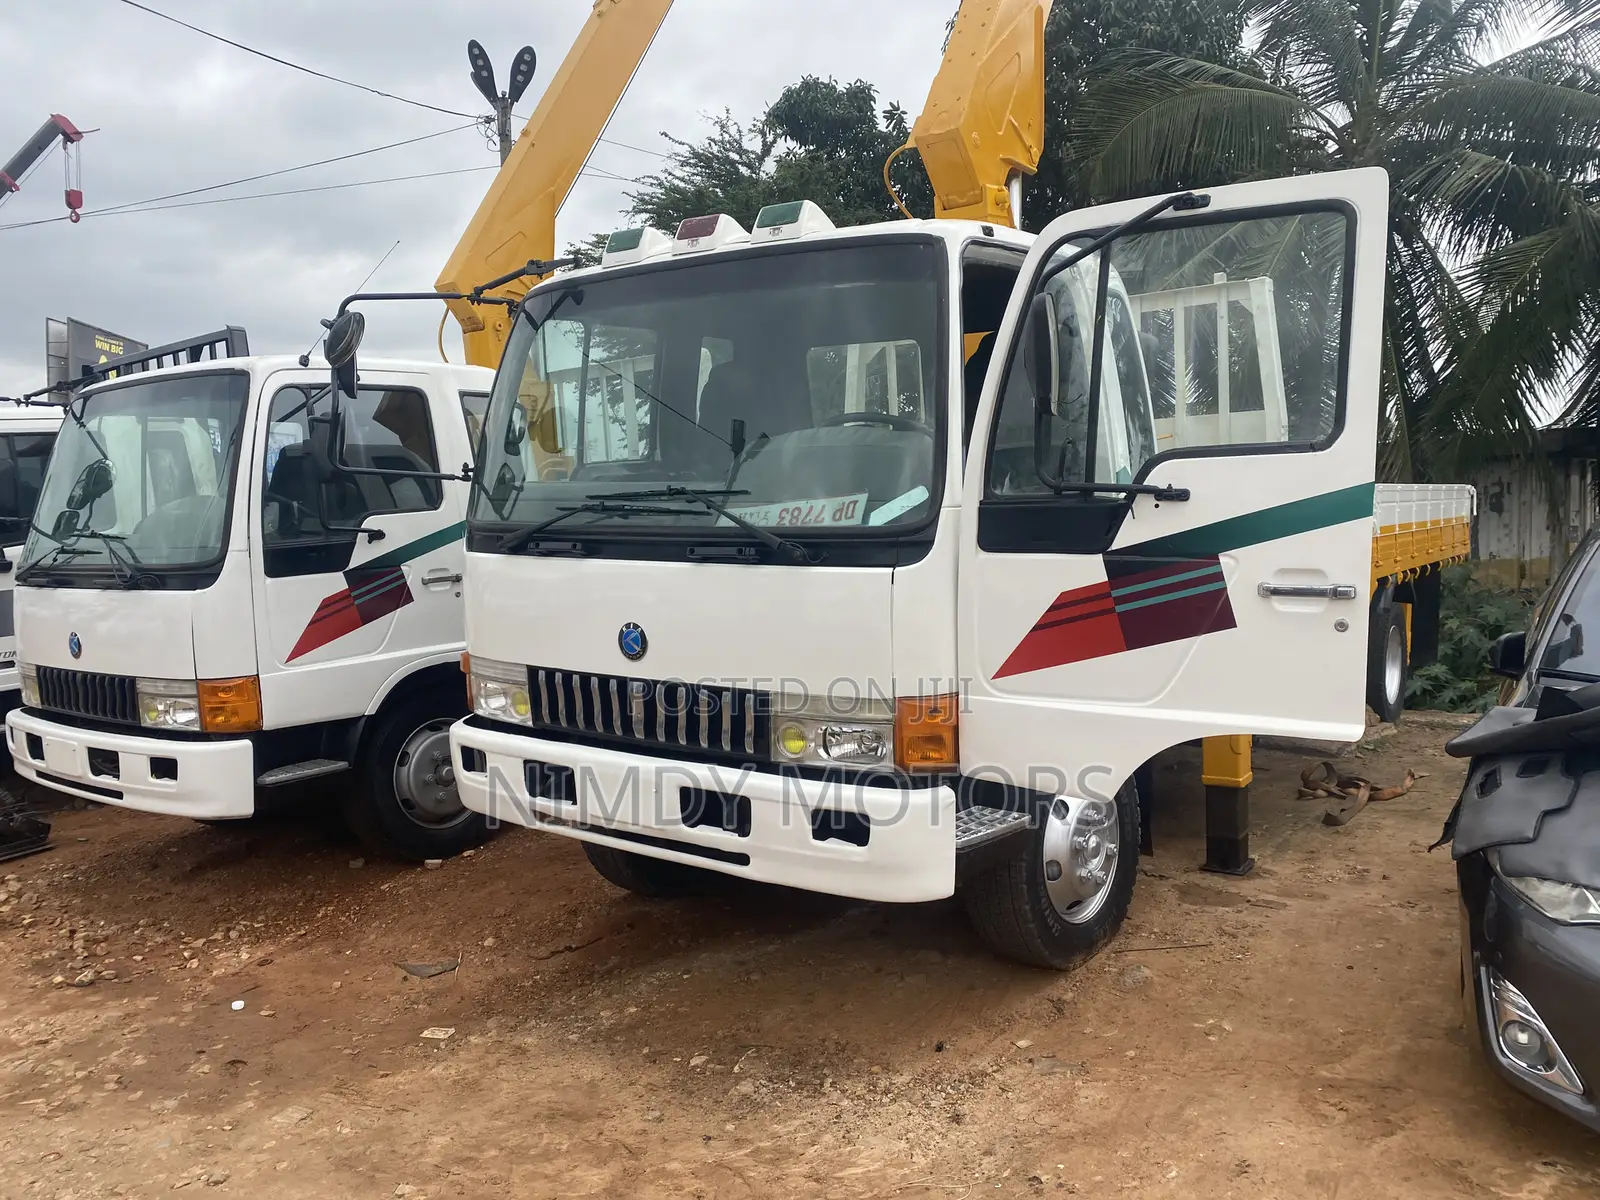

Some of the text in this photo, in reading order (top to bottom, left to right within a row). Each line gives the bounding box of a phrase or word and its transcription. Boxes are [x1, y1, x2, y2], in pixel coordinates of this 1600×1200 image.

[95, 339, 110, 352] WIN
[111, 344, 123, 355] BIG
[776, 500, 859, 526] DP 7783
